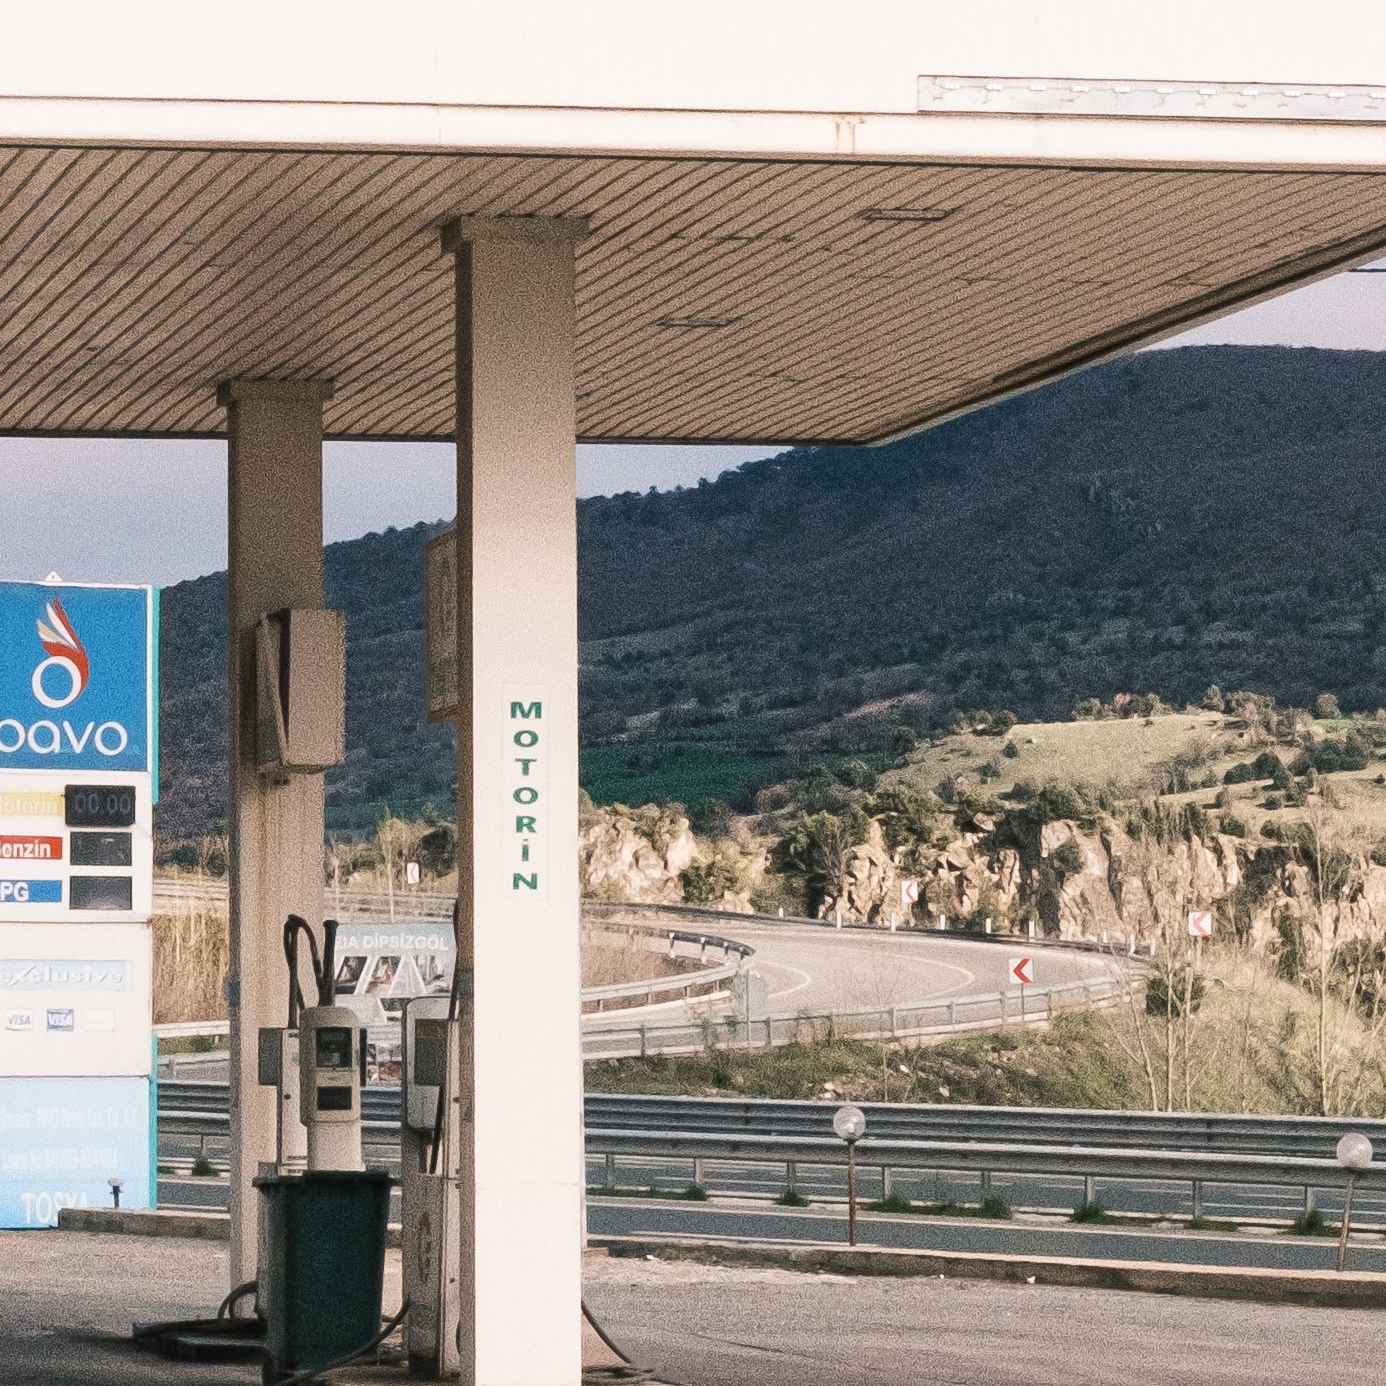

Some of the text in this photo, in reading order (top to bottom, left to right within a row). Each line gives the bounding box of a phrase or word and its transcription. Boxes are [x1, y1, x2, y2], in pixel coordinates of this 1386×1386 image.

[0, 794, 58, 815] otorin
[0, 839, 51, 858] enzin
[0, 881, 30, 902] PG
